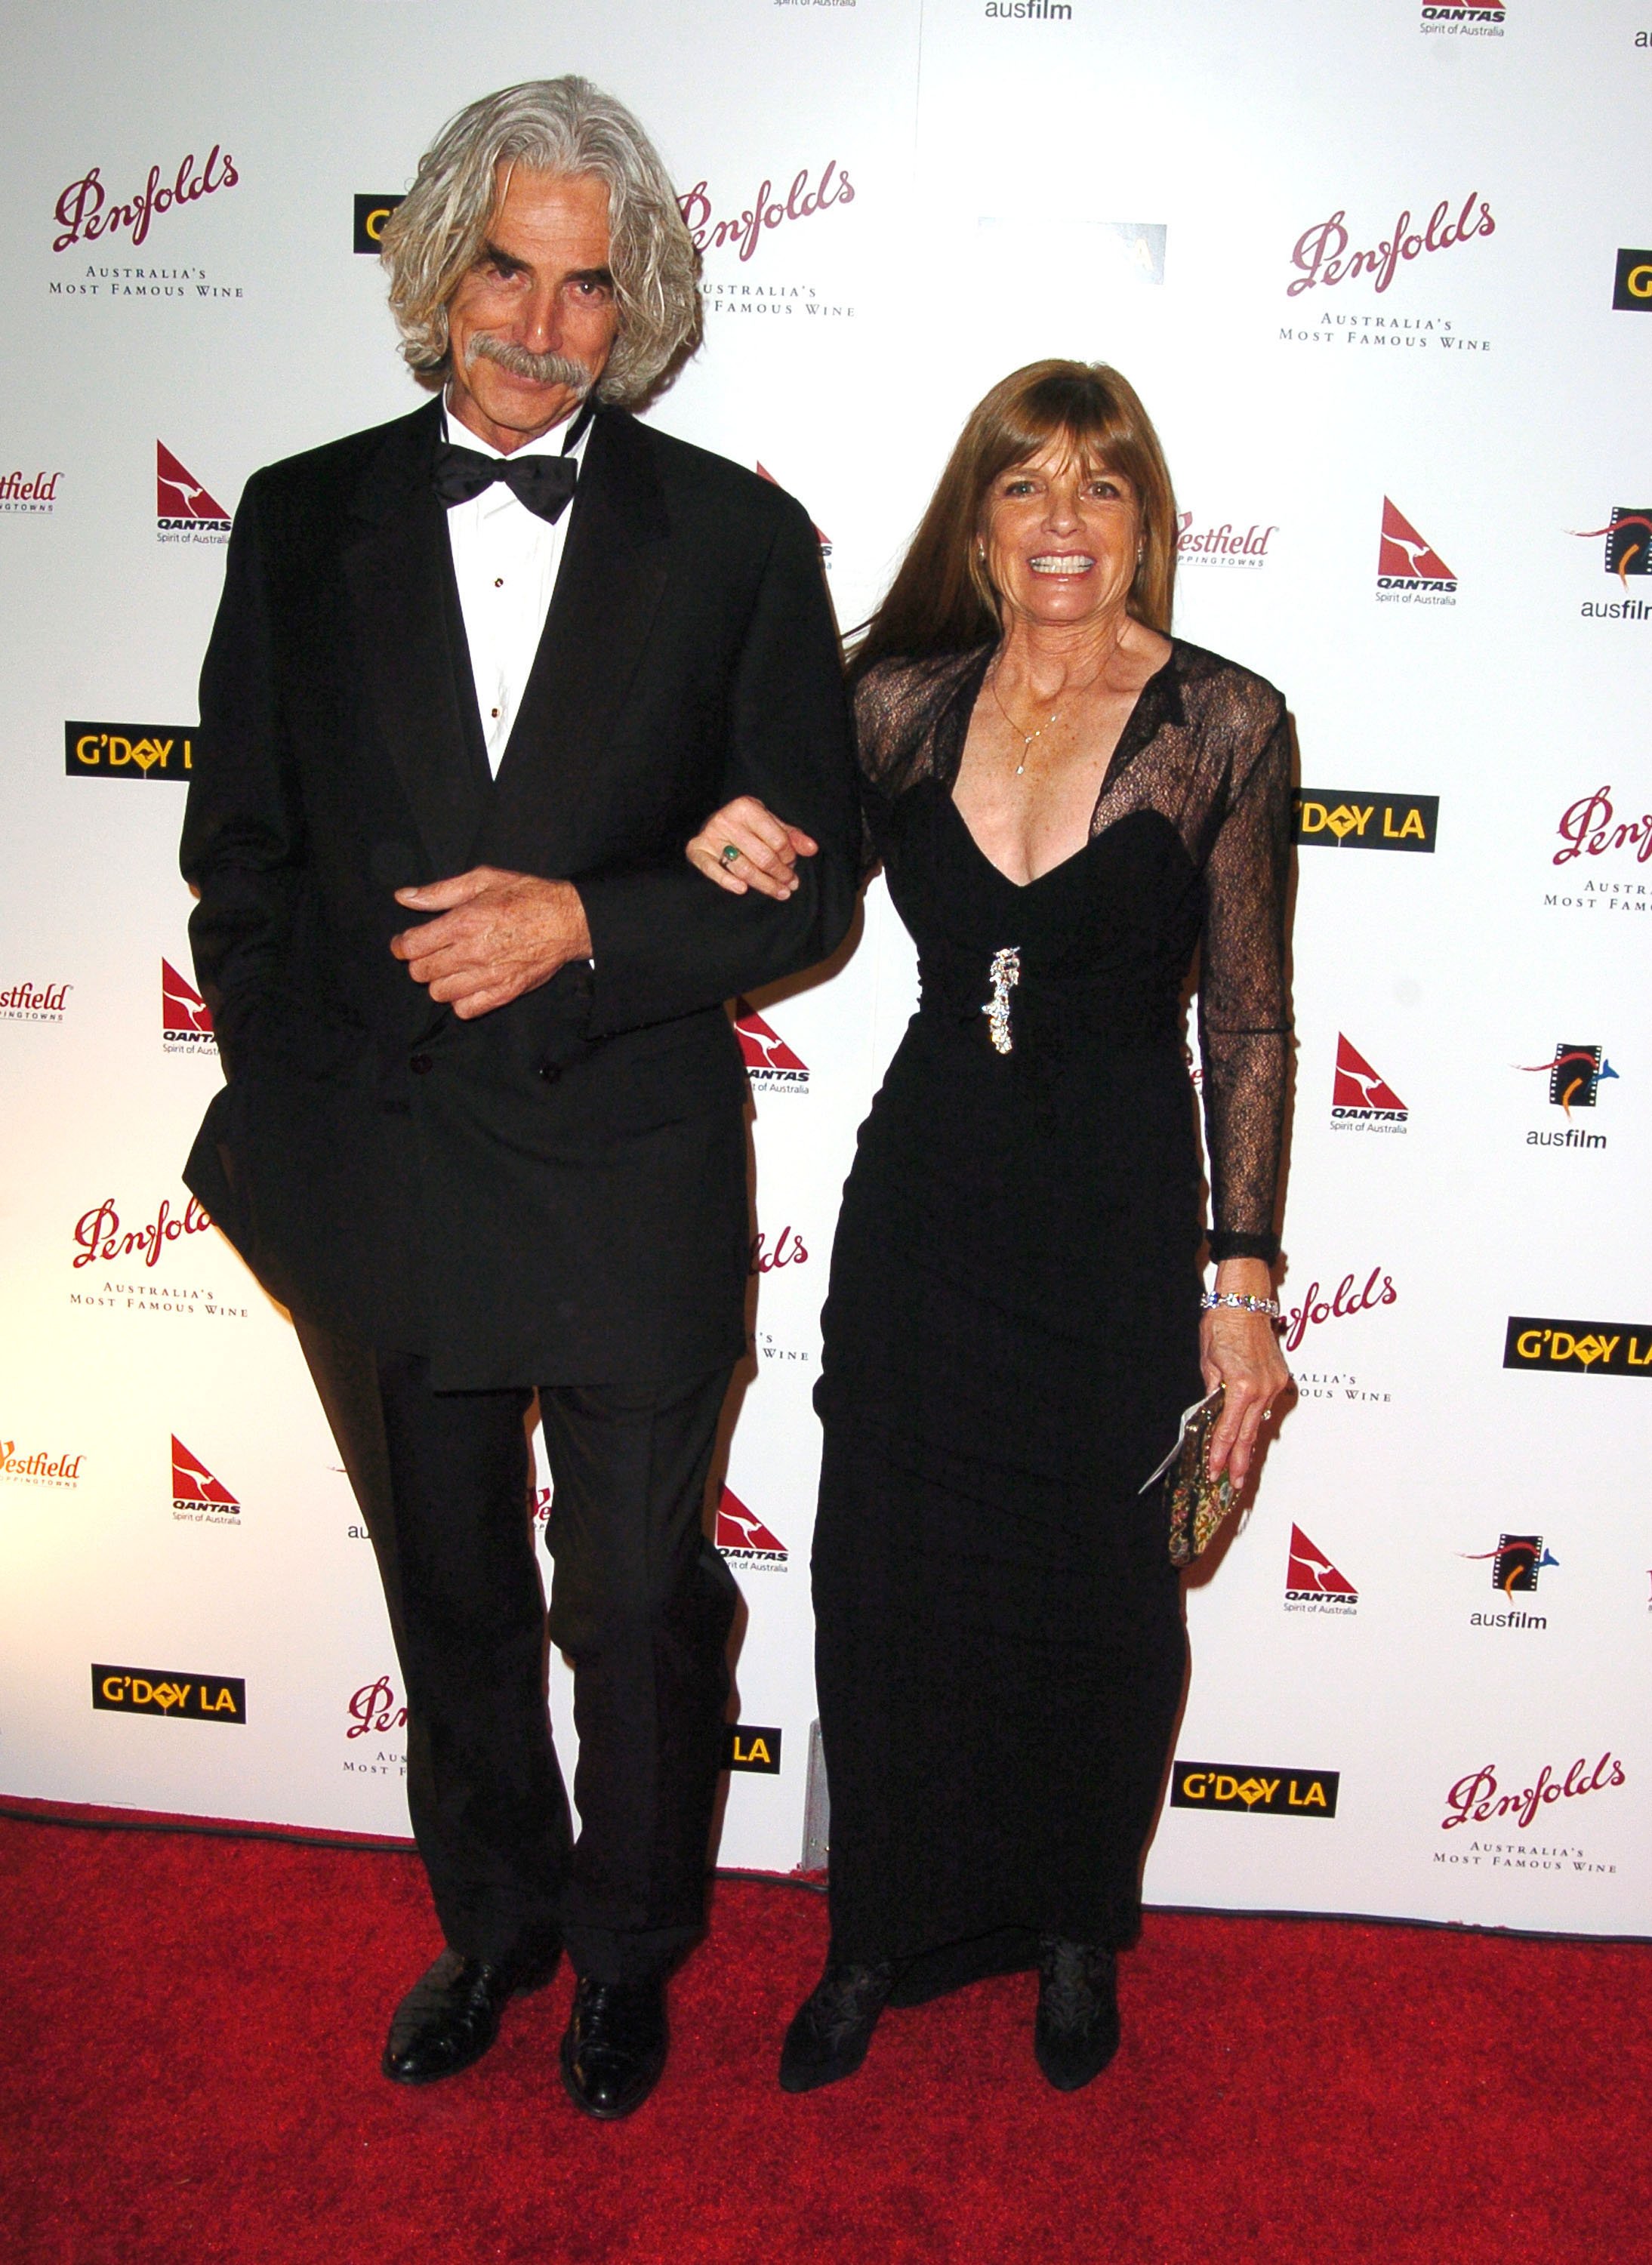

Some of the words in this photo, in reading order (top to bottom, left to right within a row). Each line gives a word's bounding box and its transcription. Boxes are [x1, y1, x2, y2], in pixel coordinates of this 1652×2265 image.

[985, 0, 1072, 20] ausfilm
[1422, 8, 1506, 23] QANTAS
[1420, 23, 1445, 35] Spirit
[1447, 24, 1459, 34] of
[1460, 26, 1504, 36] Australia
[53, 145, 239, 252] Penfolds
[1287, 192, 1495, 297] Penfolds
[50, 282, 98, 294] MOST
[112, 284, 183, 296] FAMOUS
[196, 285, 242, 297] WINE
[703, 284, 816, 297] USTRALIA'S
[715, 300, 791, 313] FAMOUS
[806, 304, 855, 317] WINE
[1280, 328, 1333, 342] MOST
[1348, 332, 1426, 347] FAMOUS
[1441, 337, 1490, 350] WINE
[157, 519, 232, 532] QANTAS
[156, 532, 180, 543] Spirit
[181, 533, 190, 543] of
[1376, 578, 1457, 593] QANTAS
[1375, 592, 1399, 603] Spirit
[1402, 593, 1412, 602] of
[1414, 595, 1456, 606] Australia
[184, 741, 193, 769] L
[1383, 808, 1425, 839] LA
[1584, 880, 1652, 895] AUSTR
[1545, 895, 1596, 908] MOST
[1609, 898, 1652, 912] FAM
[162, 1043, 184, 1054] Spirit
[186, 1045, 195, 1054] of
[748, 1069, 810, 1082] ANTAS
[757, 1083, 769, 1092] of
[769, 1084, 811, 1096] Australia
[1331, 1108, 1408, 1121] QANTAS
[1330, 1121, 1353, 1131] Spirit
[1355, 1123, 1365, 1131] of
[1367, 1123, 1407, 1134] Australia
[1527, 1129, 1606, 1148] ausfilm
[71, 1294, 115, 1306] MOST
[128, 1299, 193, 1312] FAMOUS
[205, 1305, 247, 1317] WINE
[763, 1348, 808, 1361] WINE
[1345, 1390, 1390, 1401] WINE
[173, 1500, 241, 1515] QANTAS
[172, 1512, 194, 1522] Spirit
[205, 1515, 241, 1525] Australia
[739, 1561, 748, 1570] of
[750, 1562, 789, 1573] Australia
[1285, 1592, 1358, 1604] QANTAS
[1284, 1603, 1305, 1612] Spirit
[1318, 1606, 1357, 1615] Australia
[1471, 1612, 1546, 1629] ausfilm
[201, 1687, 236, 1712] LA
[733, 1736, 771, 1763] LA
[344, 1761, 387, 1774] MOST
[1289, 1781, 1326, 1806] LA
[1441, 1752, 1625, 1829] Penfolds
[1434, 1853, 1481, 1864] MOST
[1493, 1857, 1562, 1870] FAMOUS
[1573, 1862, 1616, 1872] WINE
